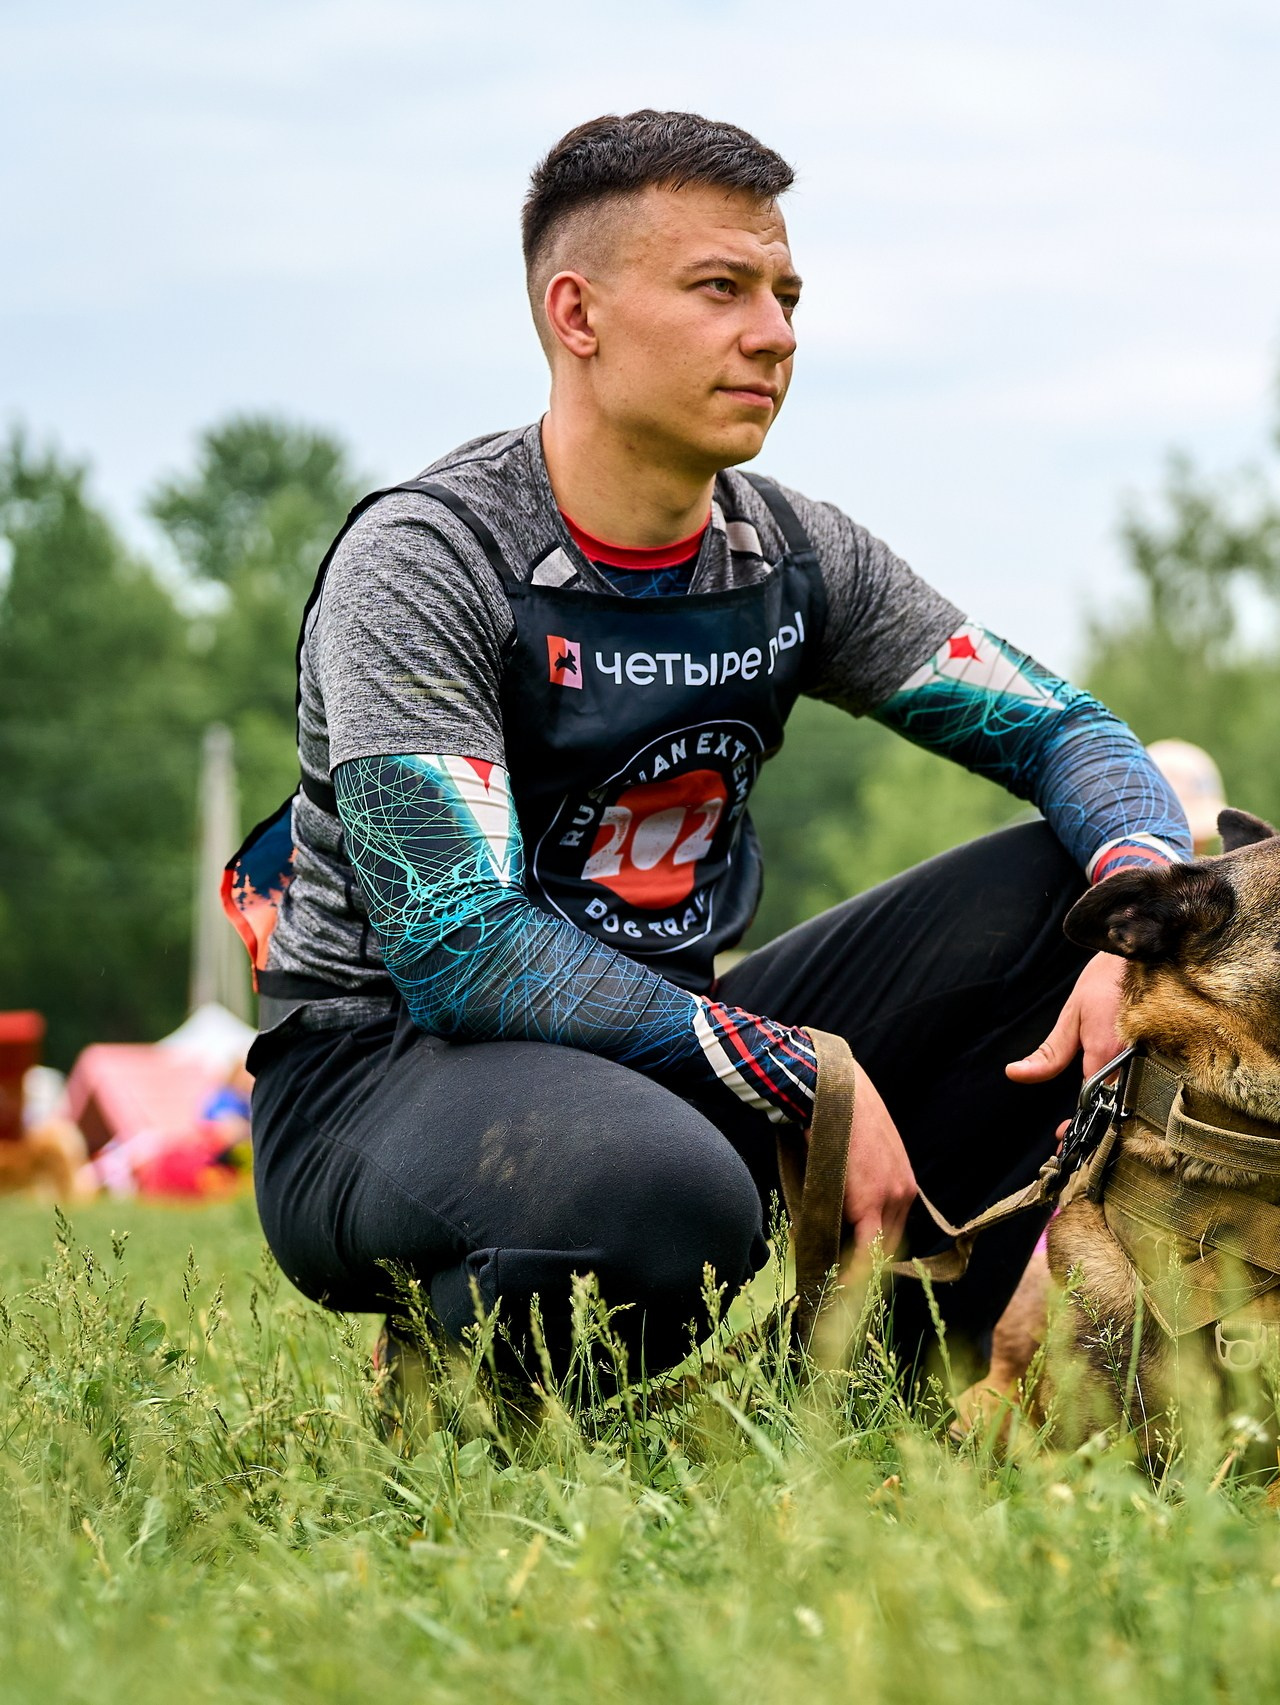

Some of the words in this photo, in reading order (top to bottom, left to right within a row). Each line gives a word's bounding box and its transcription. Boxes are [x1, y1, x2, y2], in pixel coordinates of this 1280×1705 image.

[595, 646, 763, 686] четыре
[766, 611, 805, 675] лы
[584, 897, 643, 938] DOG
